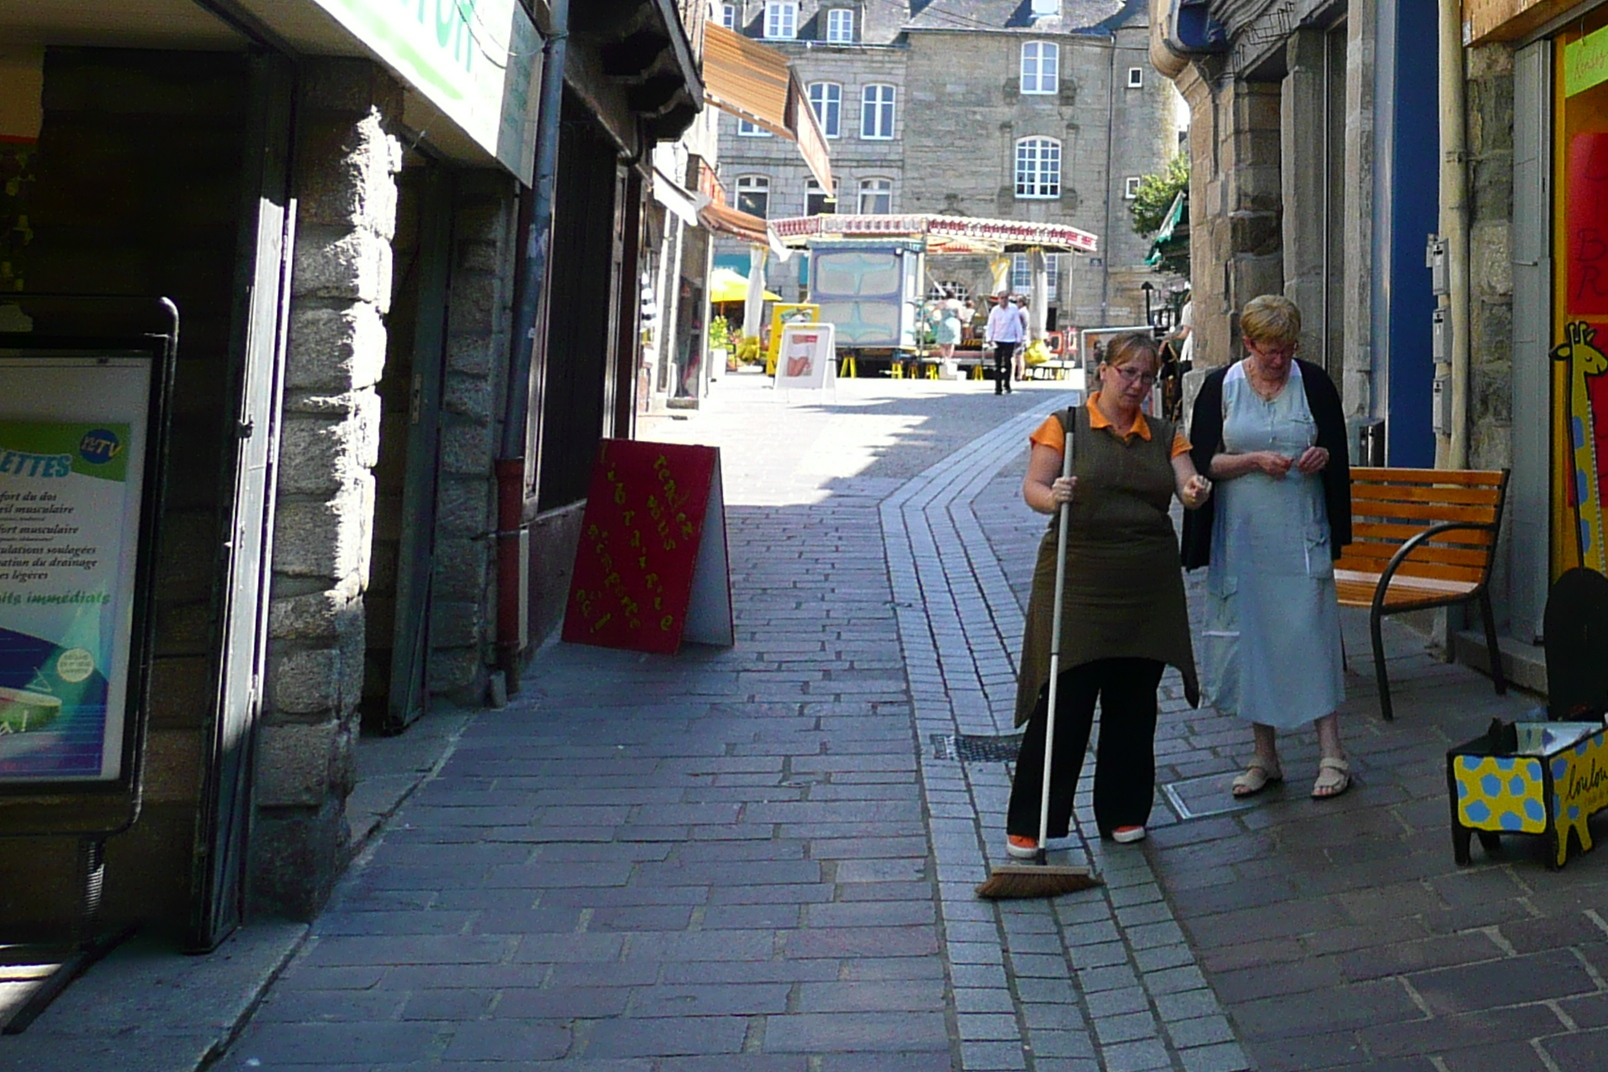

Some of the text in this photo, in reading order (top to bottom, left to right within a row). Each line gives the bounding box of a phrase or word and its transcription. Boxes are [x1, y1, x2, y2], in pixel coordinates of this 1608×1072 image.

[15, 503, 75, 515] musculaire
[19, 522, 80, 535] musculaire
[48, 556, 99, 571] drainage
